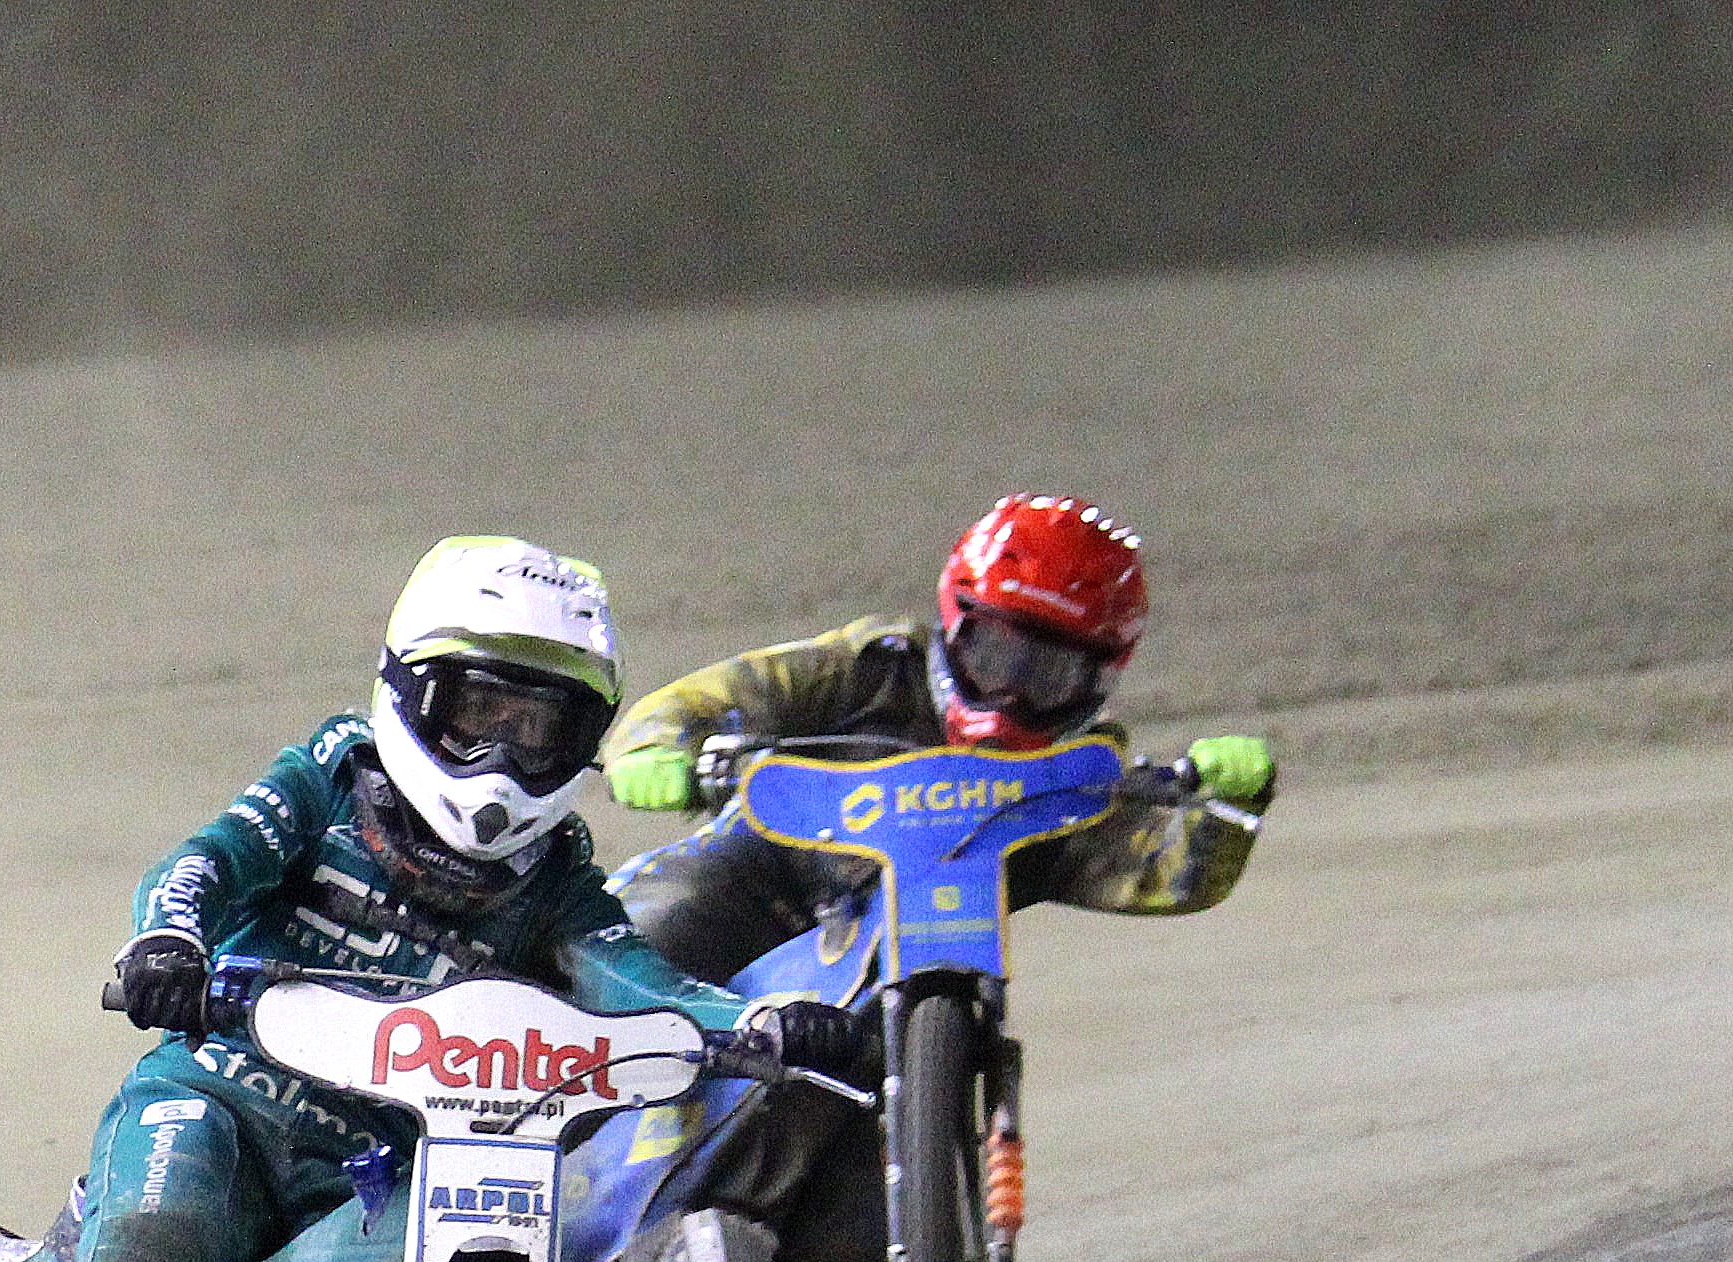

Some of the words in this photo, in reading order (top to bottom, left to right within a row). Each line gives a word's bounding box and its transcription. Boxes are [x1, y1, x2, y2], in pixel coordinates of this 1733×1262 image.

[895, 779, 1025, 814] KGHM
[371, 1007, 618, 1100] Pentel
[429, 1185, 551, 1217] ARPOL
